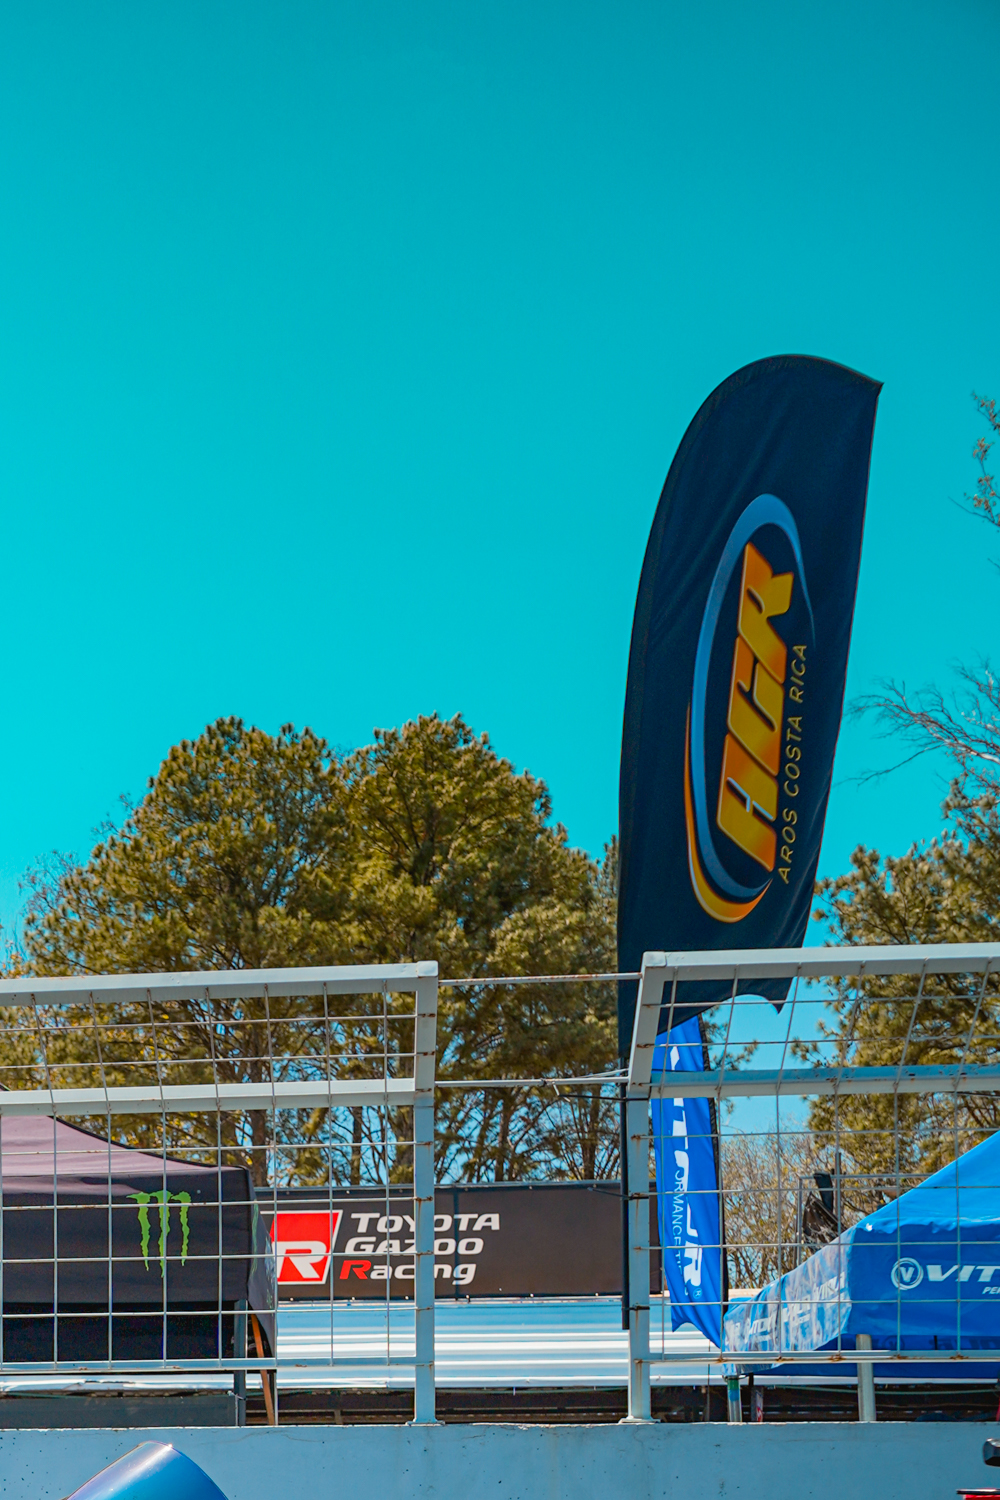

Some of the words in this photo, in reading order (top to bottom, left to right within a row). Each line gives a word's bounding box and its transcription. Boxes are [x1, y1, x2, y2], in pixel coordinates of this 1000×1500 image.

[717, 541, 795, 874] ACR
[789, 644, 807, 703] RICA
[784, 715, 803, 798] COSTA
[779, 808, 798, 885] AROS
[351, 1212, 500, 1233] TOYOTA
[339, 1259, 477, 1285] Racng
